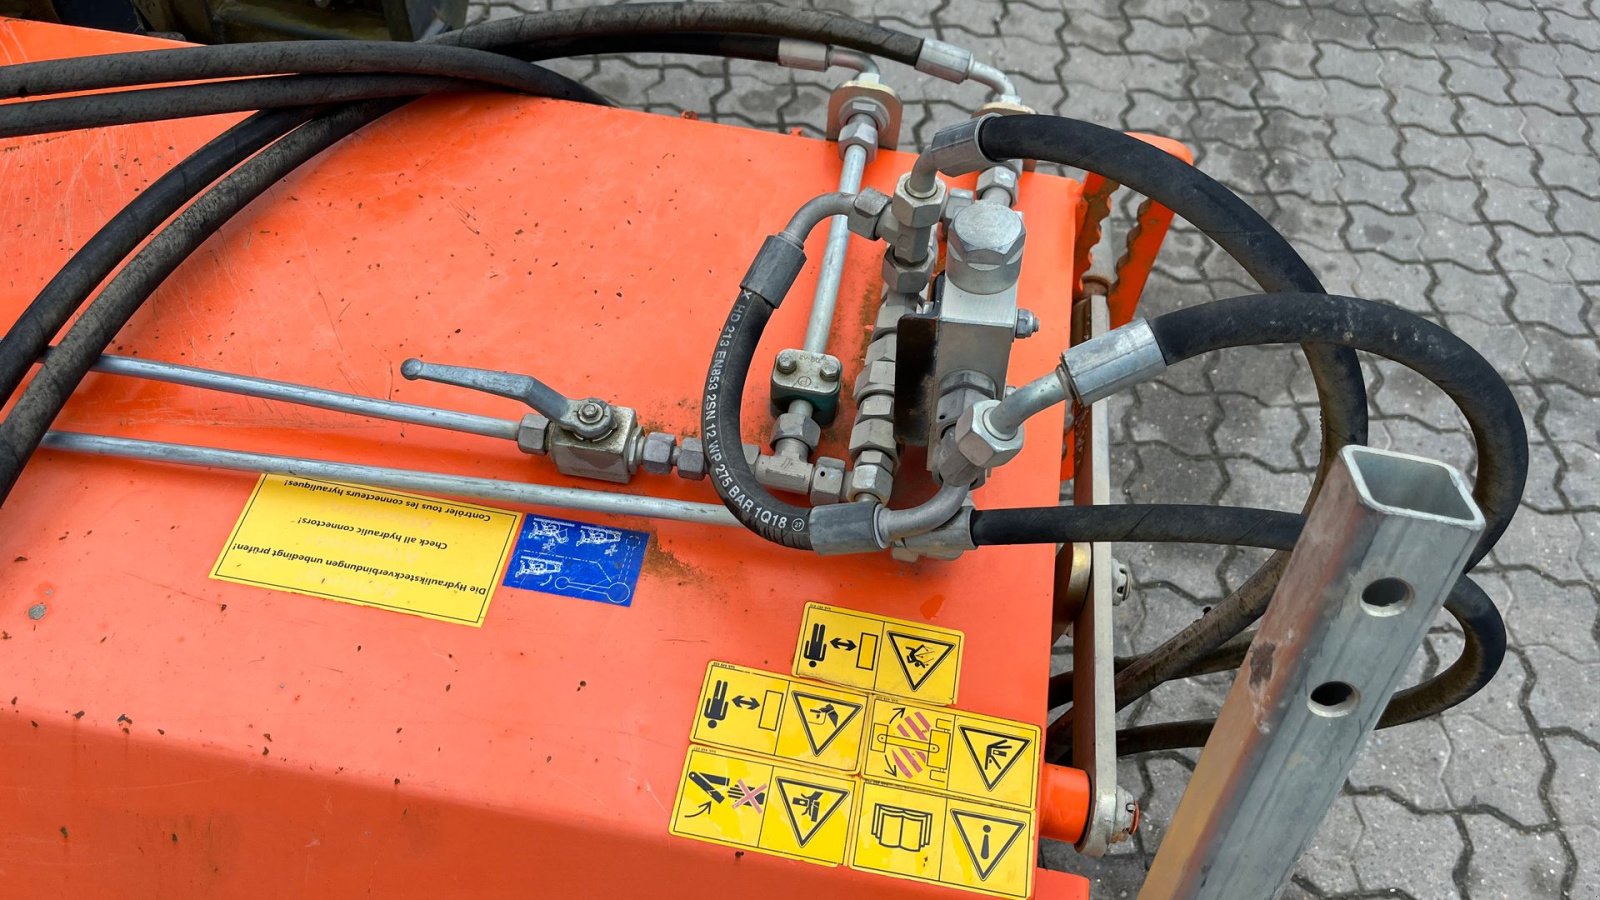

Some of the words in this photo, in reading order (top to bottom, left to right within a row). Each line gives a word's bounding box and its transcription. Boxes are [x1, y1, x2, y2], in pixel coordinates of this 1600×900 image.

[730, 304, 745, 322] HD
[720, 325, 735, 347] 213
[708, 350, 727, 391] EN853
[705, 394, 717, 421] 2SN
[706, 423, 716, 439] 12
[708, 440, 722, 462] WP
[715, 464, 734, 487] 275
[284, 480, 344, 497] hyrauliques!
[346, 490, 403, 507] connecteurs
[405, 501, 419, 510] les
[728, 486, 754, 512] BAR
[421, 504, 442, 514] tous
[445, 508, 491, 522] Contrôler
[297, 517, 354, 533] connectors!
[755, 507, 788, 529] 1Q18
[357, 527, 402, 543] hydraulic
[404, 536, 417, 546] all
[419, 538, 448, 549] Check
[232, 543, 271, 556] prüfen!
[272, 549, 323, 566] unbedingt
[326, 559, 467, 592] Hydrauliksteckverbindungen
[469, 585, 486, 595] Die
